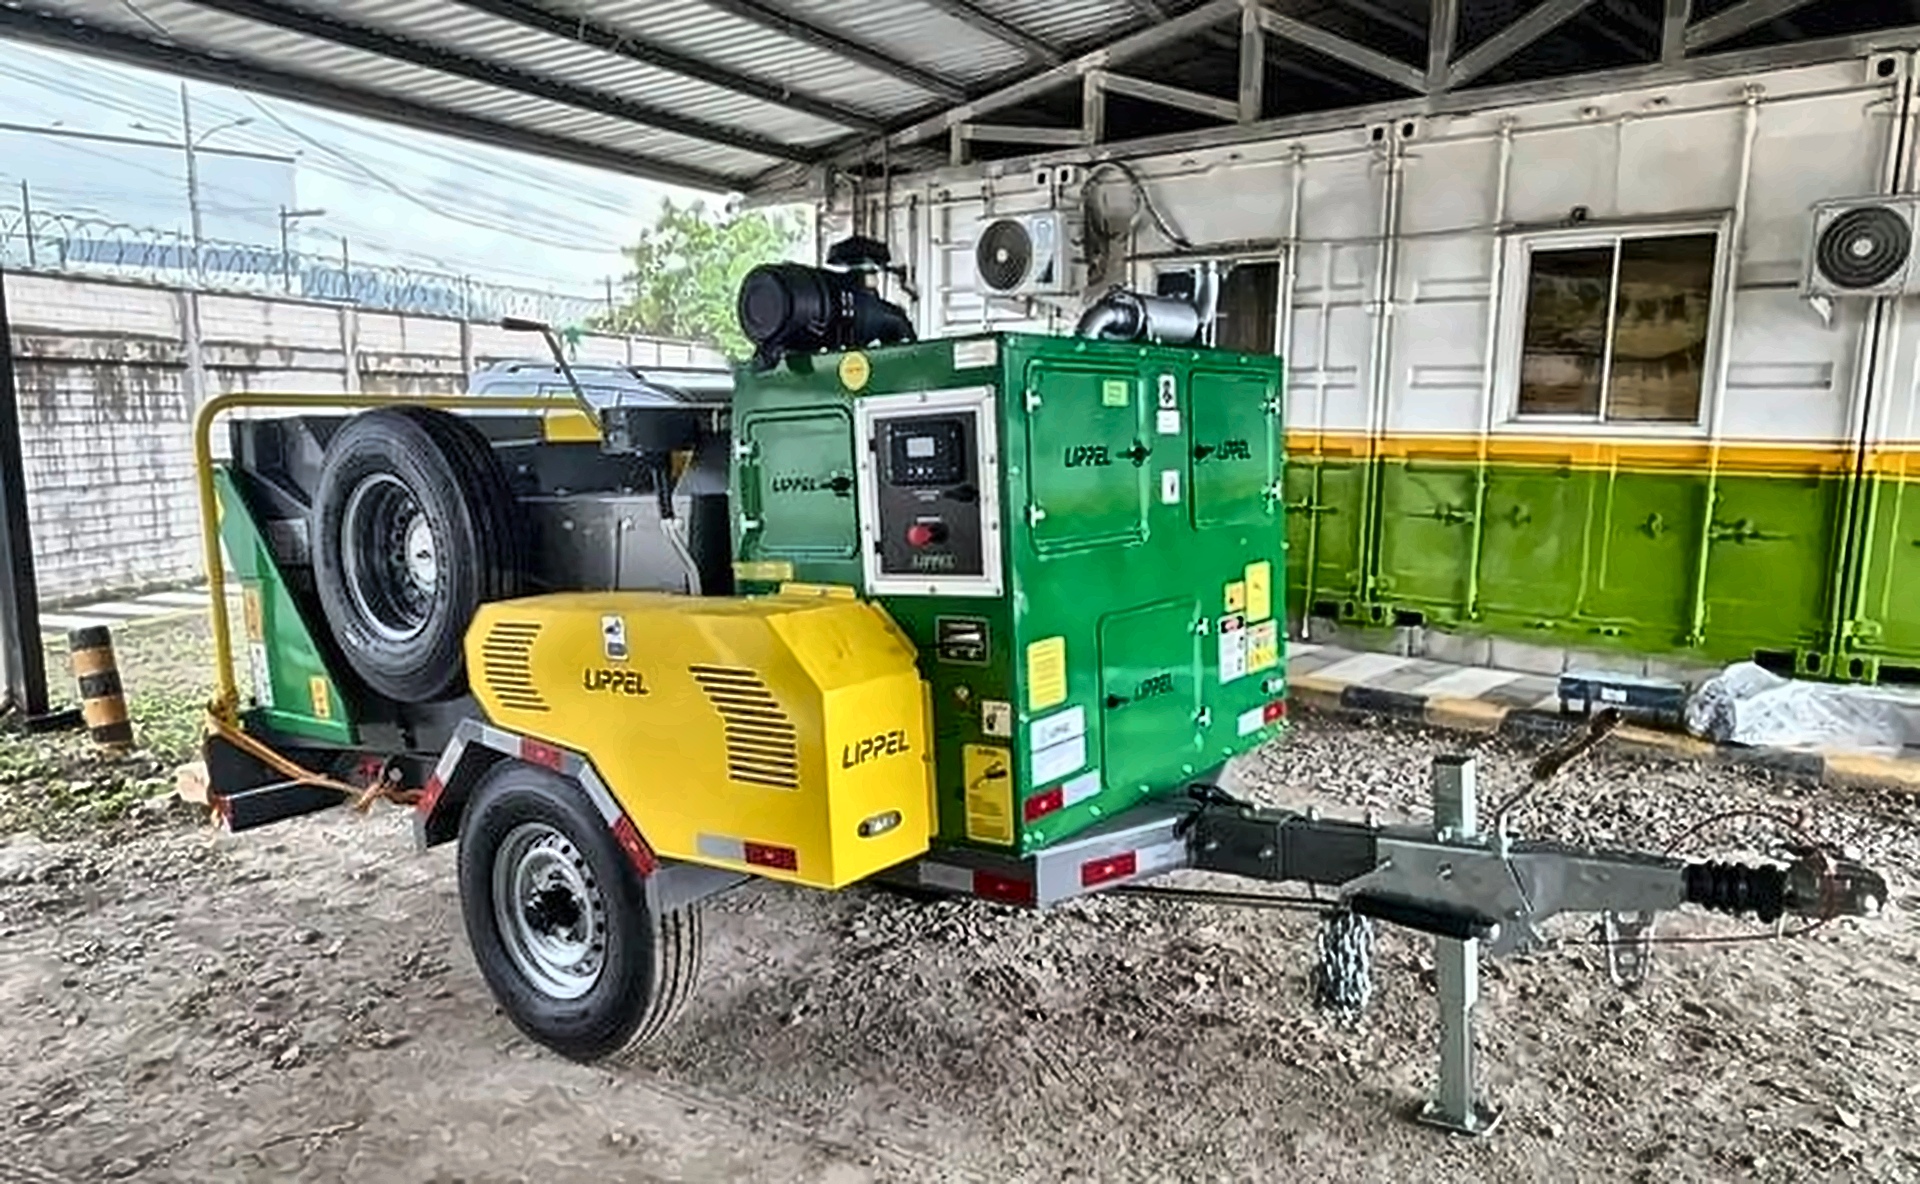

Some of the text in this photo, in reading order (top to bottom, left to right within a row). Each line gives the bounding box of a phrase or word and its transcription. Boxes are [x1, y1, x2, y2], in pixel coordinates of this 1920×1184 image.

[1065, 446, 1111, 468] LIPPEL
[583, 668, 650, 695] LIPPEL
[842, 729, 910, 770] LIPPEL
